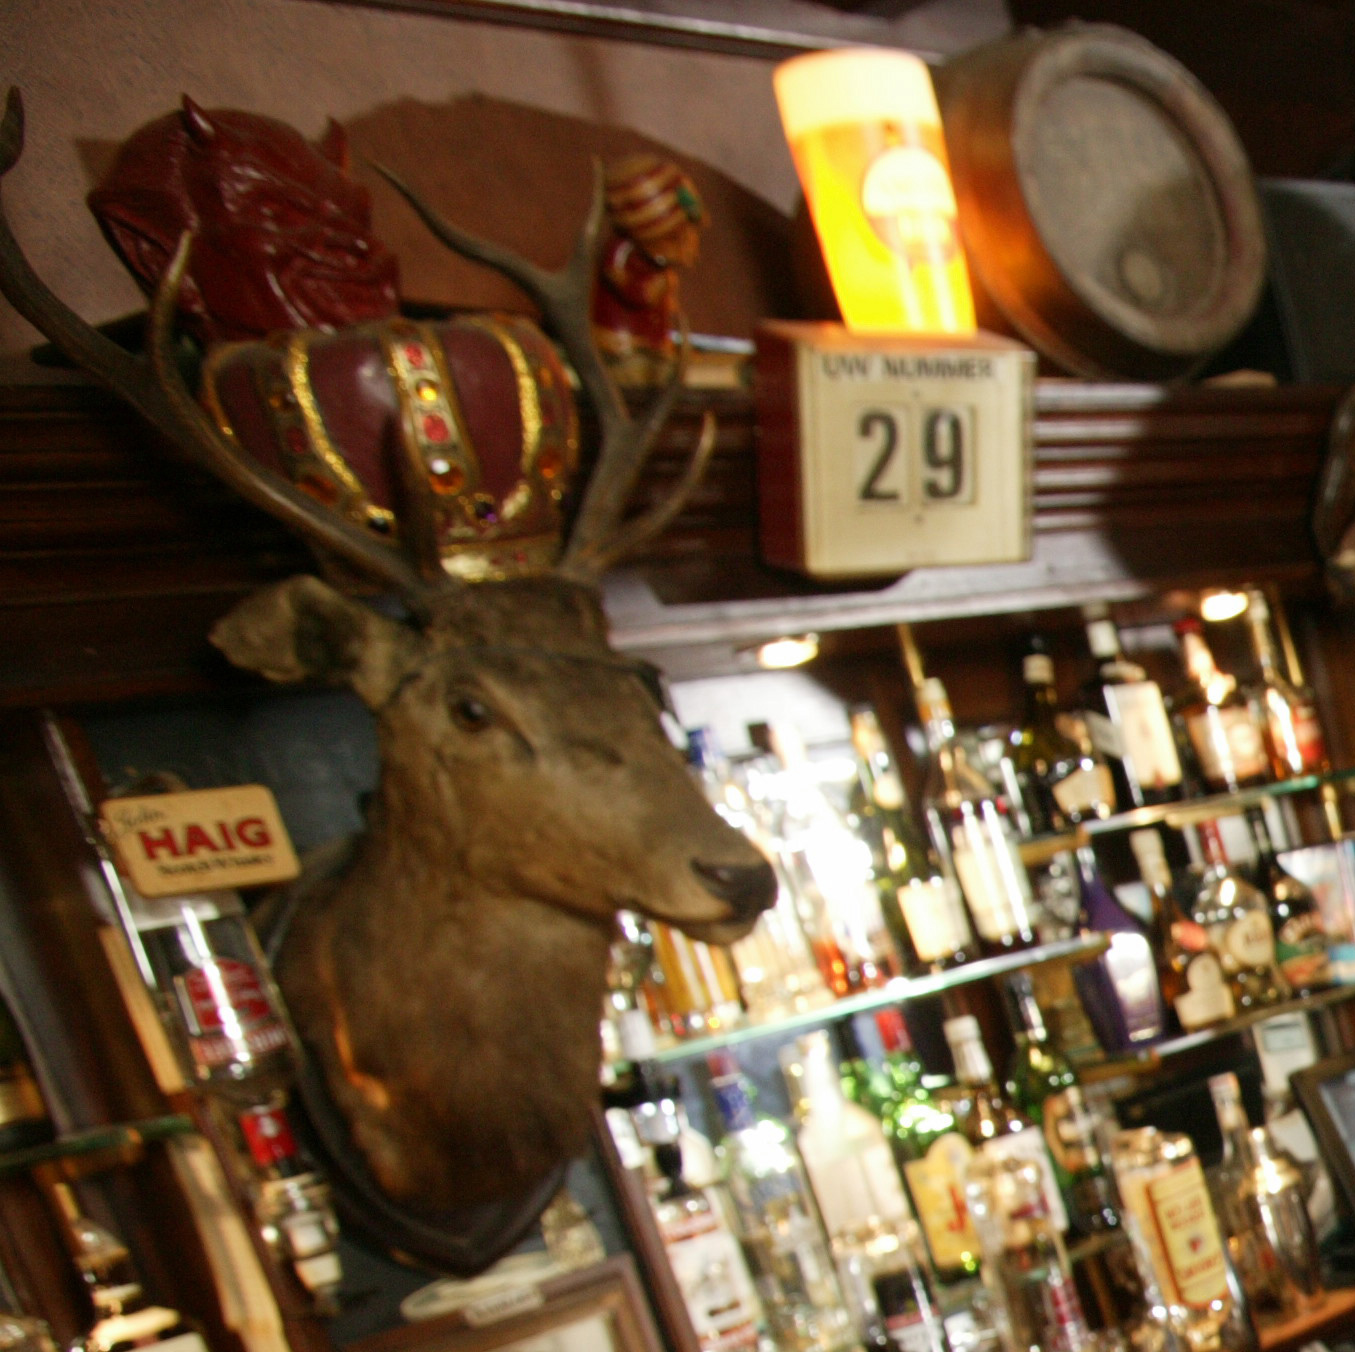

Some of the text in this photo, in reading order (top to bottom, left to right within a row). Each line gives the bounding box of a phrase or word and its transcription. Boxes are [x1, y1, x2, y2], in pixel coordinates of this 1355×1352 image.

[882, 356, 993, 379] NUMMER
[858, 407, 964, 502] 29
[138, 816, 272, 860] HAIG
